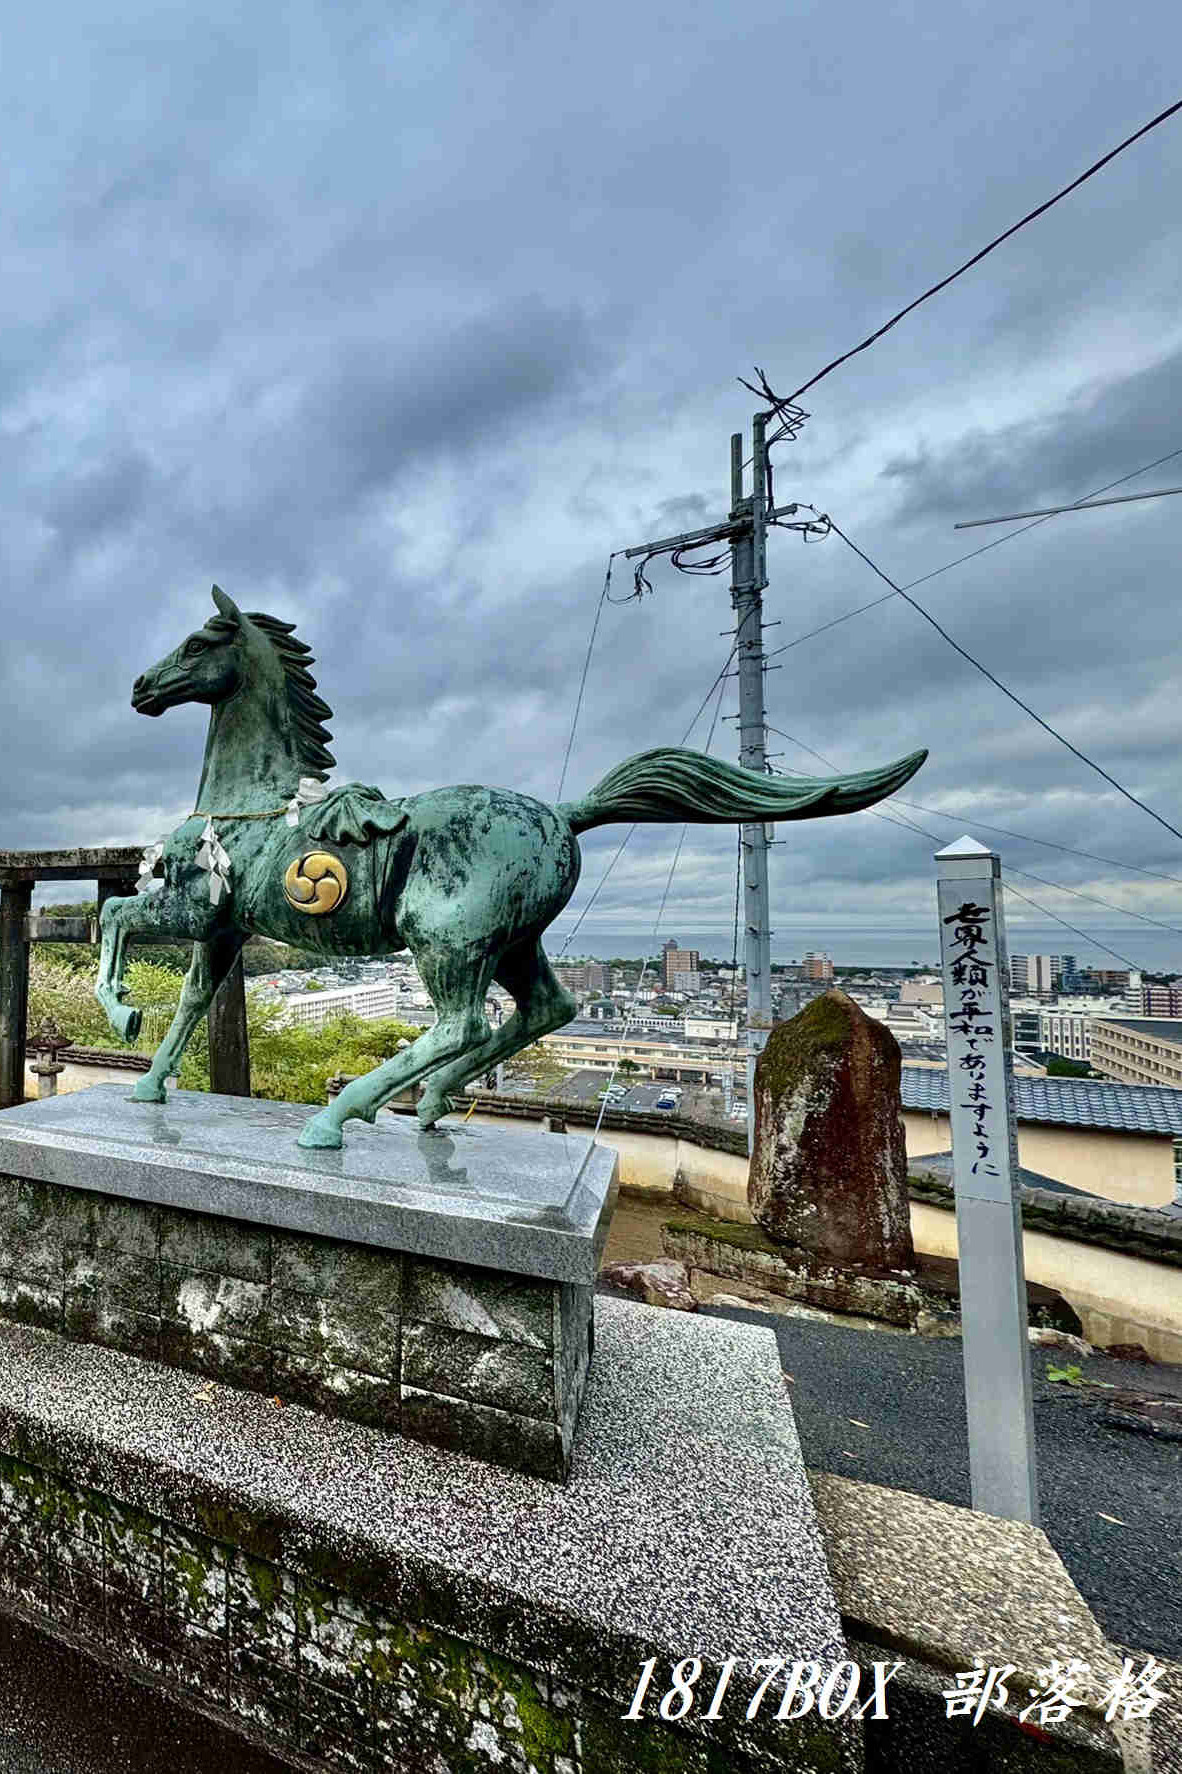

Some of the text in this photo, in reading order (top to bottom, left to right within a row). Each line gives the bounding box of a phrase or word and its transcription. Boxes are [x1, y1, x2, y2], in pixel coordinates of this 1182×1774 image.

[943, 902, 1000, 1177] 世界人類が平和でありますように
